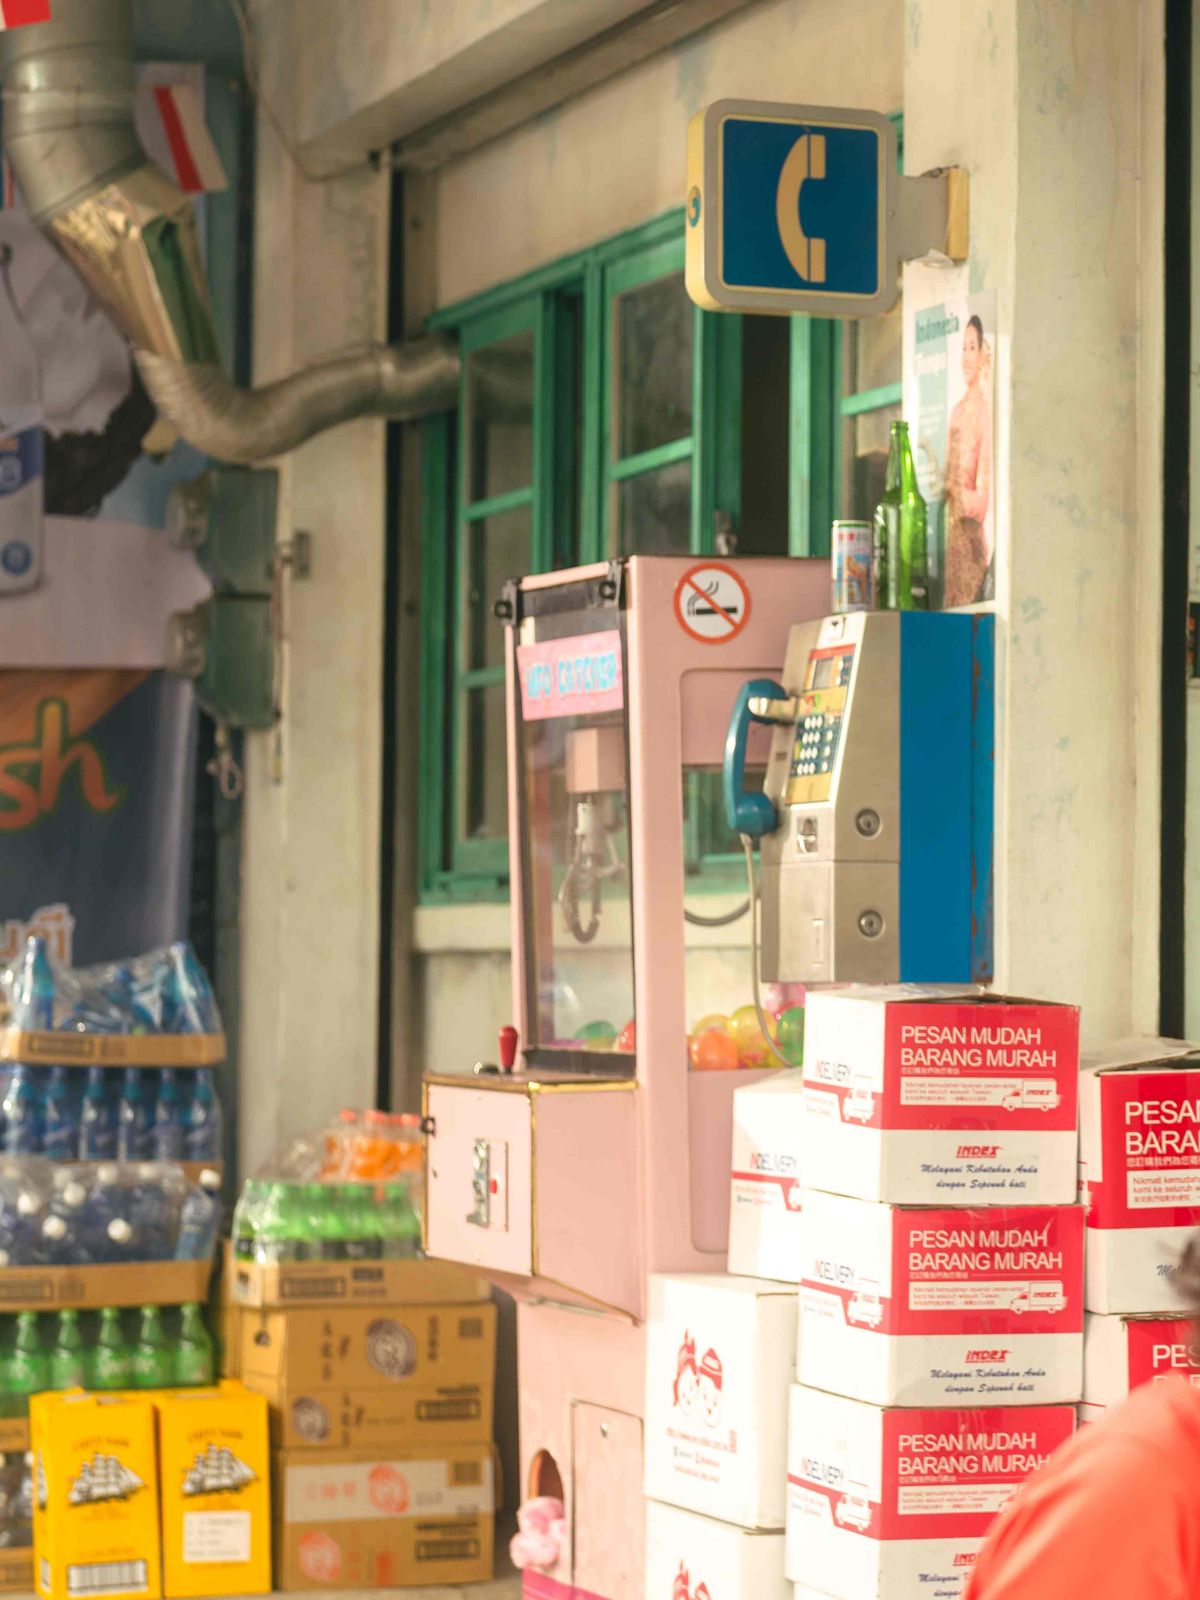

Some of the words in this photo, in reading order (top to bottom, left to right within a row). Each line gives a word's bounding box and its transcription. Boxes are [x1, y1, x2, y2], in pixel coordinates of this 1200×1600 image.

[901, 1026, 966, 1044] PESAN
[971, 1027, 1041, 1045] MUDAH
[901, 1048, 982, 1067] BARANG
[986, 1049, 1057, 1068] MURAH
[909, 1230, 975, 1248] PESAN
[979, 1230, 1048, 1248] MUDAH
[909, 1252, 990, 1271] BARANG
[994, 1252, 1063, 1270] MURAH
[899, 1434, 963, 1452] PESAN
[967, 1432, 1036, 1450] MUDAH
[899, 1456, 978, 1475] BARANG
[982, 1454, 1050, 1474] MURAH
[953, 1554, 976, 1565] IND
